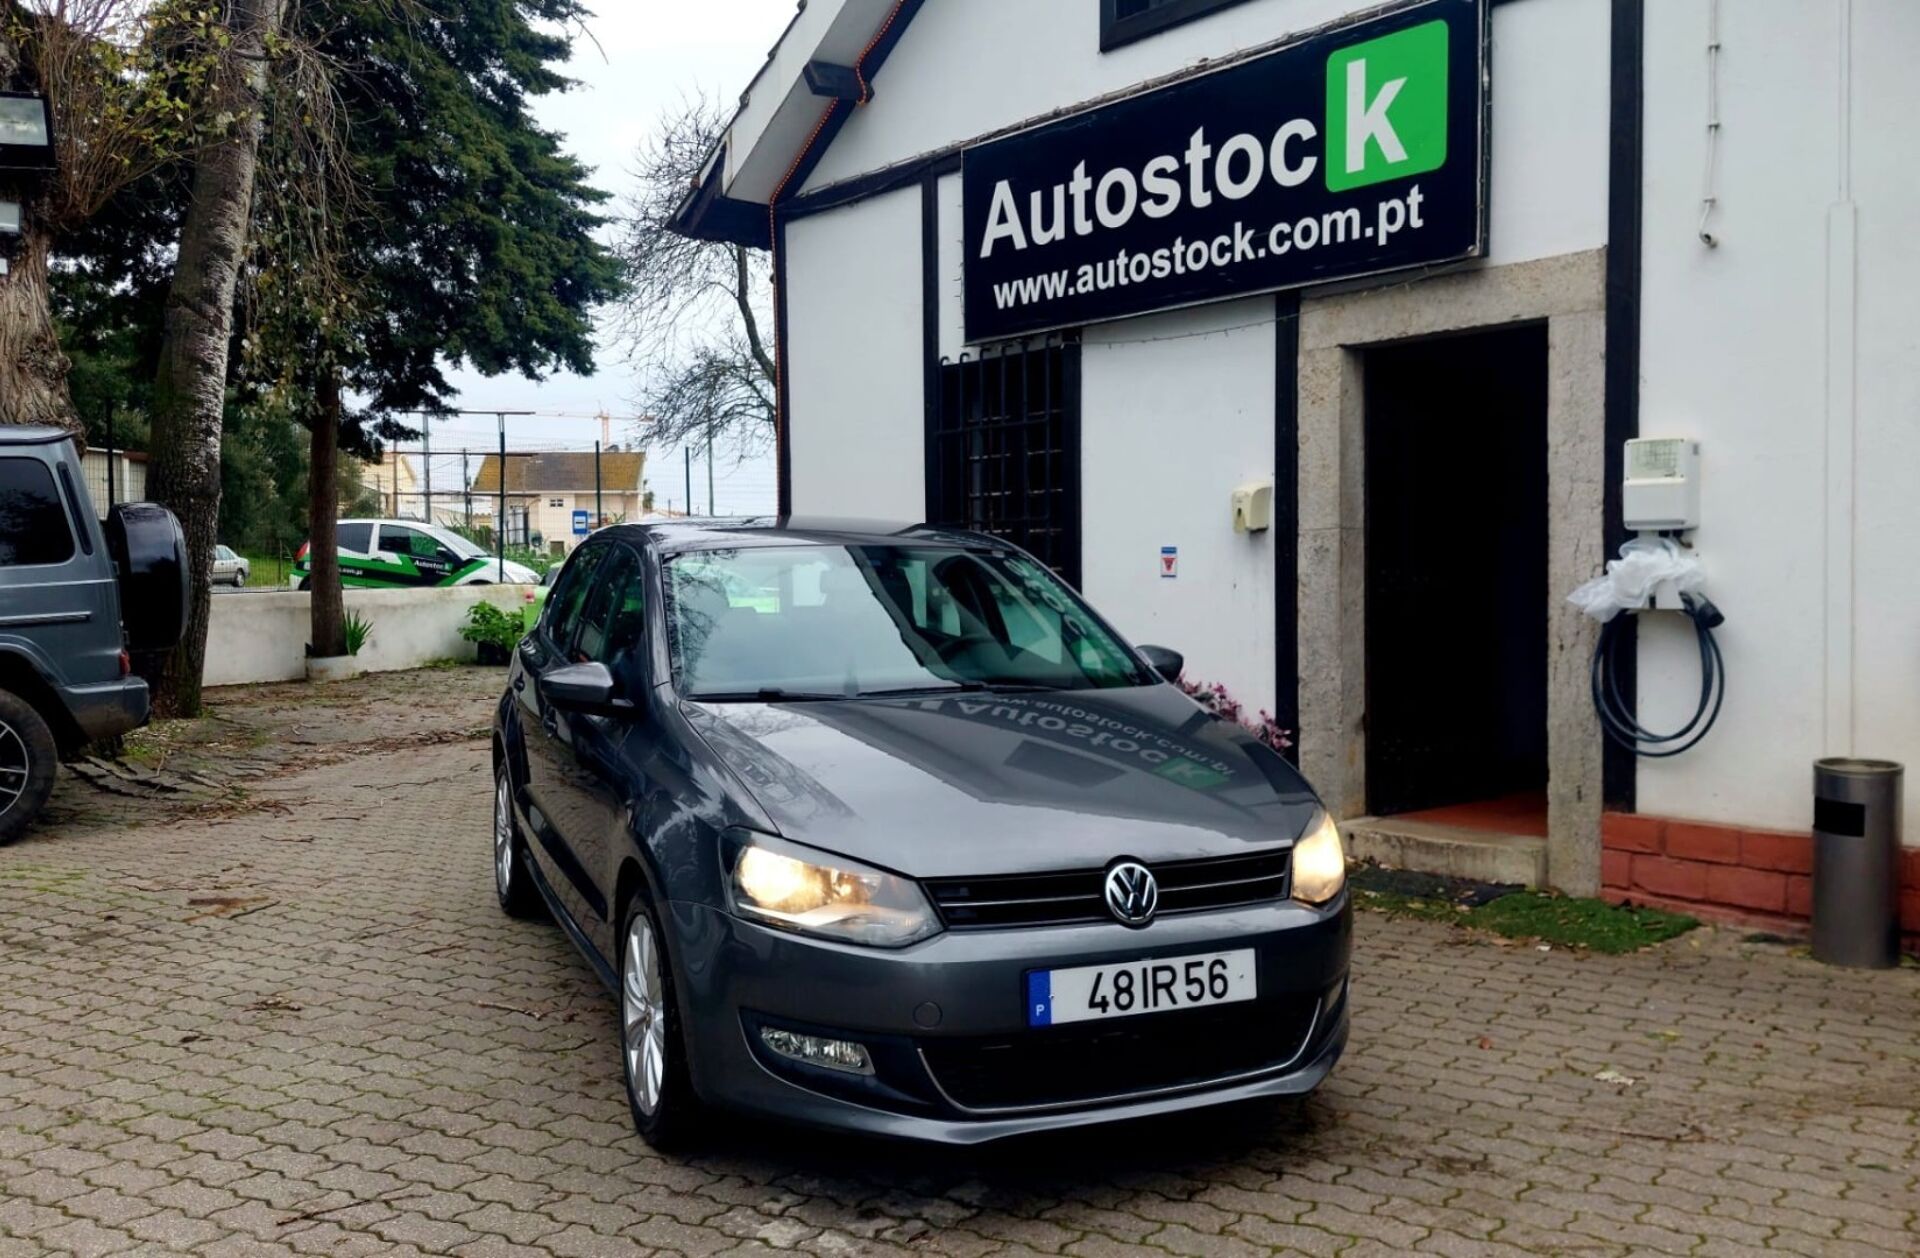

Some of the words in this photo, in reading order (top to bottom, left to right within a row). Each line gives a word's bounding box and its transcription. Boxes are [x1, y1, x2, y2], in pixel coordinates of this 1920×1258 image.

[979, 58, 1409, 259] Autostock
[993, 184, 1424, 309] www.autostock.com.pt
[1035, 1004, 1045, 1016] P
